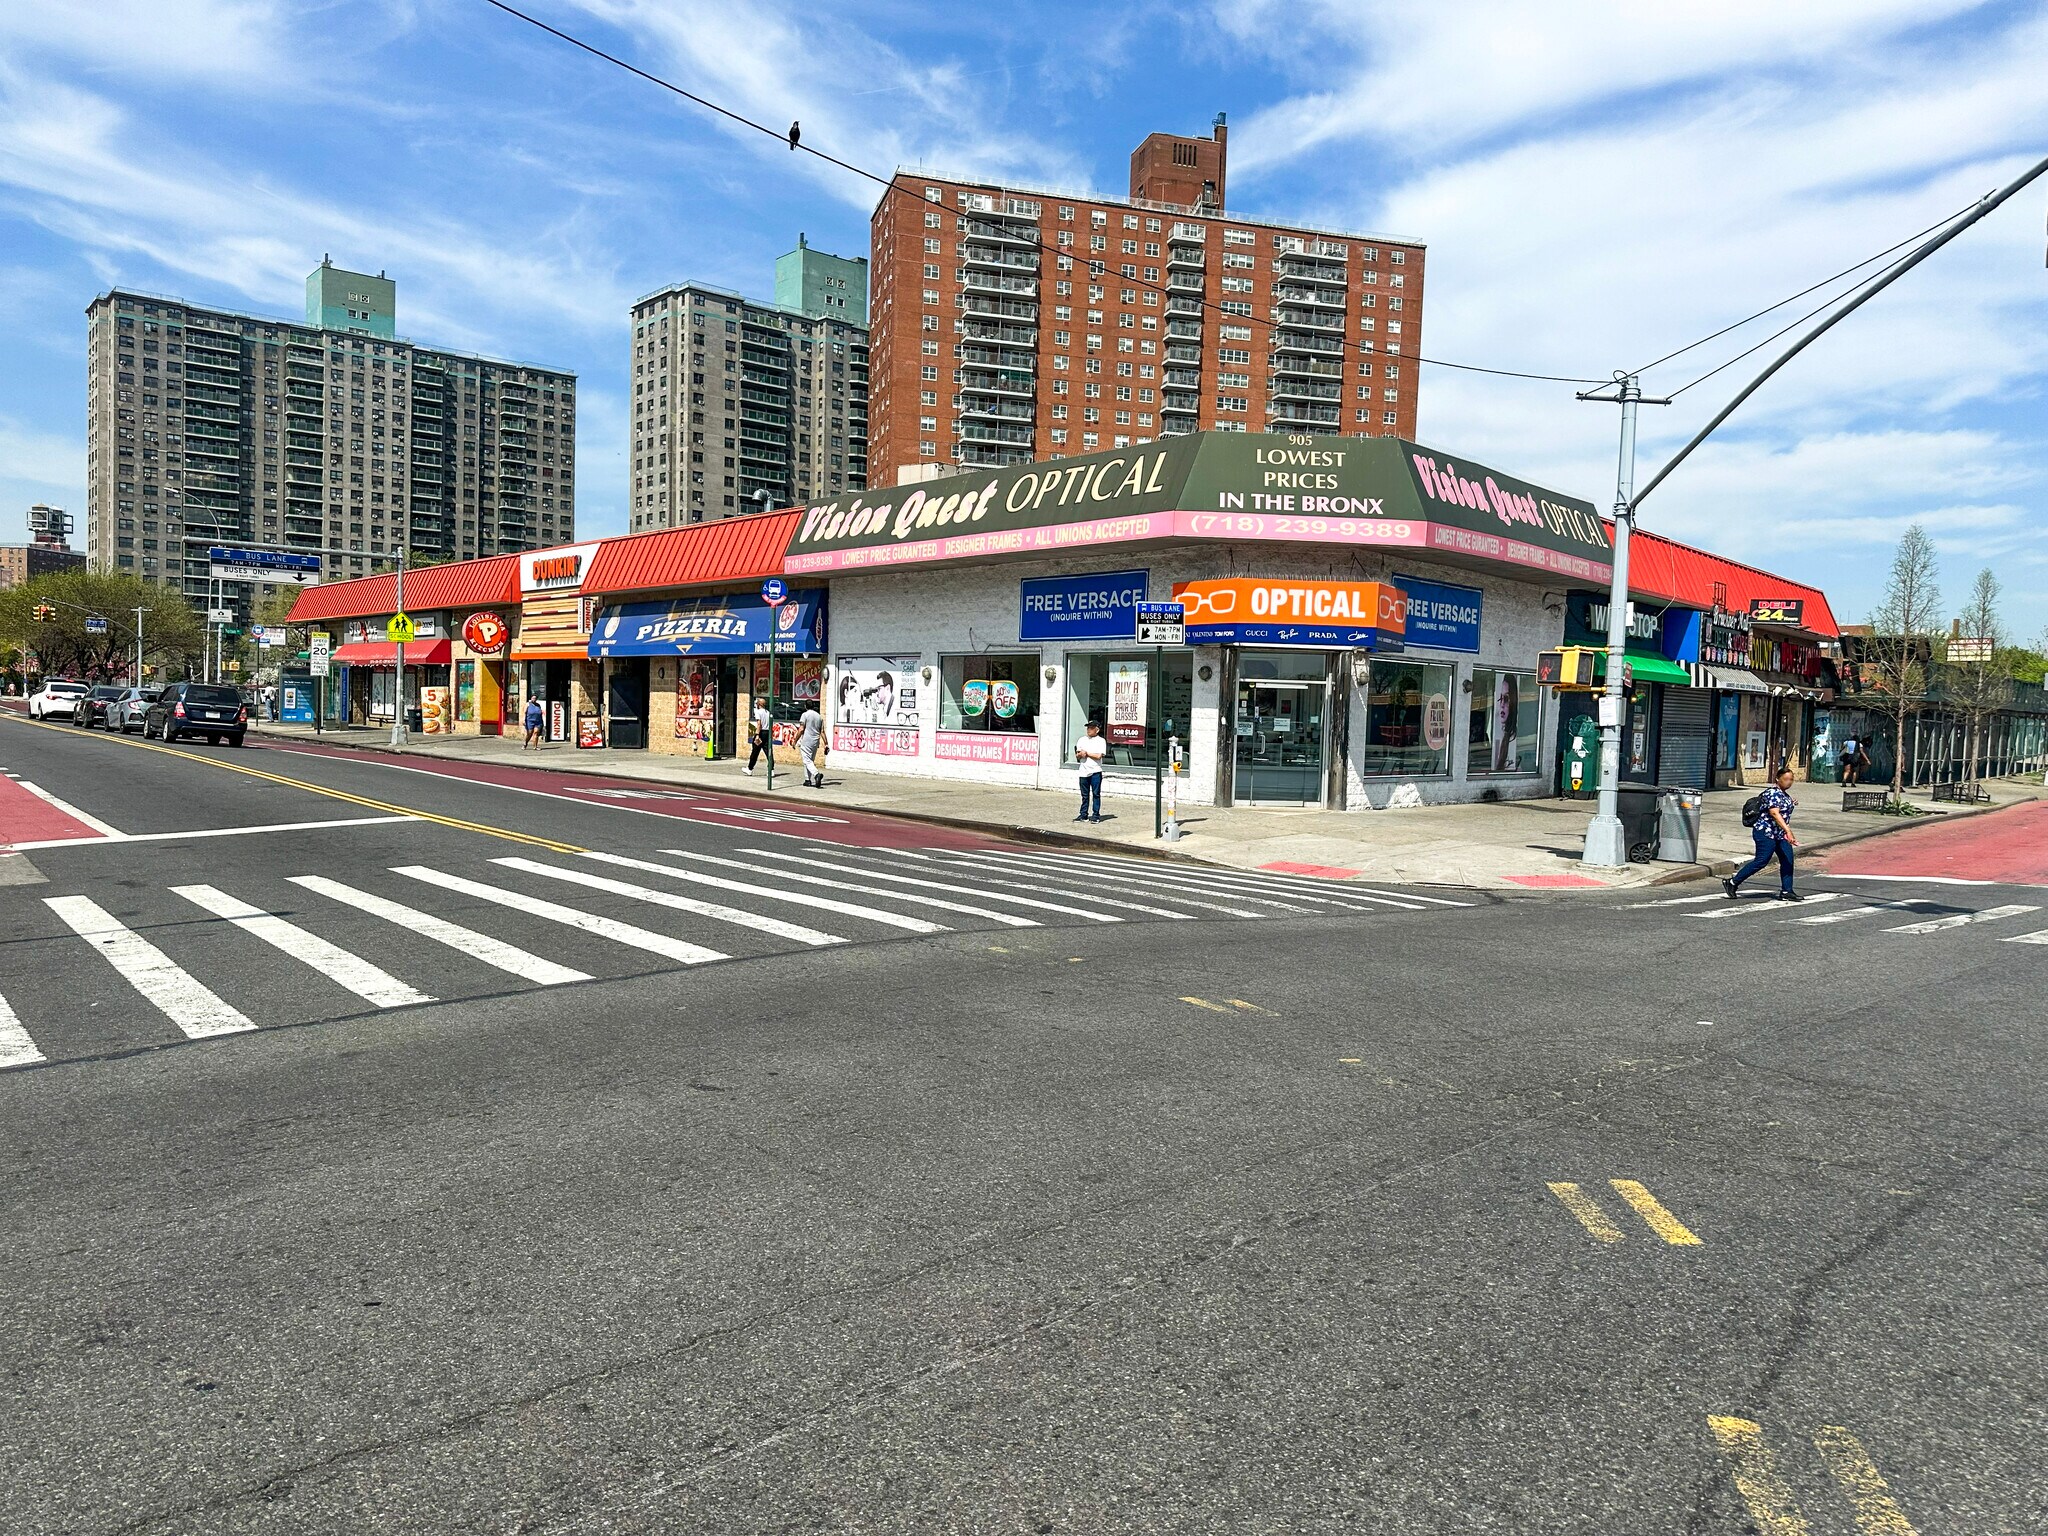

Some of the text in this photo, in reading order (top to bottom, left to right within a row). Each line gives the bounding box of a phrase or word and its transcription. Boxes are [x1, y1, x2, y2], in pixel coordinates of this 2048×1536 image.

[1288, 435, 1313, 446] 905
[1256, 448, 1346, 467] LOWEST
[1264, 471, 1338, 490] PRICES
[799, 452, 1167, 543] Vision Quest OPTICAL
[1219, 492, 1384, 515] IN THE BRONX
[1413, 454, 1609, 549] Vision Quest OPTICAL
[1191, 515, 1411, 539] (718) 239-9389
[785, 518, 1150, 571] (718) 239-9389 LOWEST PRICE GURANTEED DESIGNER FRAMES ALL UNIONS ACCEPTED
[1435, 527, 1456, 546] LOWEST
[1456, 531, 1471, 549] PRICE
[1507, 542, 1529, 562] DESIGNER
[1529, 547, 1545, 566] FRAMES
[245, 552, 287, 563] BUS LANE
[223, 566, 271, 576] BUSES ONLY
[1025, 588, 1143, 612] FREE VERSACE
[1250, 587, 1367, 619] OPTICAL
[1758, 601, 1797, 610] DELI
[1150, 604, 1181, 612] BUS LANE
[1406, 598, 1478, 625] REE VERSACE
[1756, 608, 1785, 621] 24
[469, 614, 506, 632] LOUISIANA
[1050, 610, 1114, 623] (INQUIRE WITHIN)
[1140, 612, 1162, 620] BUSES
[477, 621, 499, 644] P
[635, 618, 748, 642] PIZZERIA
[1245, 629, 1269, 638] GUCCI
[1308, 631, 1338, 640] PRADA
[312, 647, 328, 656] 20
[469, 637, 504, 653] KITCHEN
[803, 665, 822, 680] TACOS
[1115, 681, 1139, 694] BUY A
[994, 695, 1016, 710] OFF
[1115, 702, 1138, 712] PAIR OF
[1114, 713, 1138, 721] GLASSES
[937, 733, 955, 741] LOWEST
[936, 743, 1003, 760] DESIGNER FRAMES
[1003, 737, 1011, 761] 1
[1011, 739, 1038, 752] HOUR
[1011, 751, 1037, 762] SERVICE
